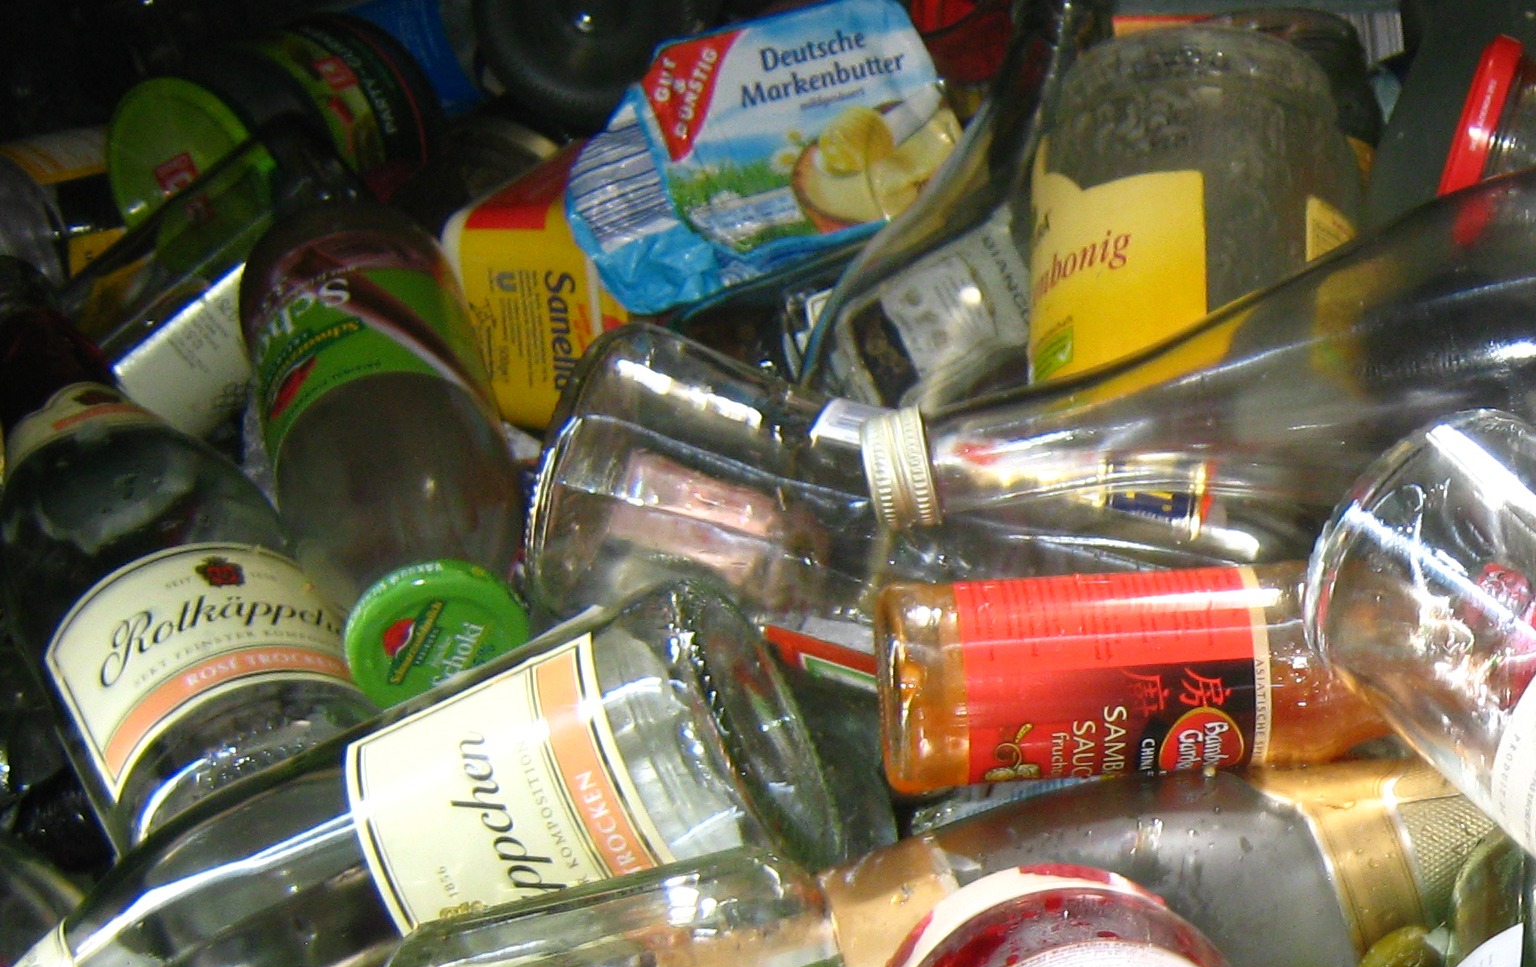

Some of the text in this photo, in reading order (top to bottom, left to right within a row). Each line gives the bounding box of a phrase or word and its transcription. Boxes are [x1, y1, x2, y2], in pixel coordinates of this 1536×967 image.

[740, 50, 906, 109] Markenbutter
[760, 29, 867, 72] Deutsche
[543, 267, 578, 391] Sanella
